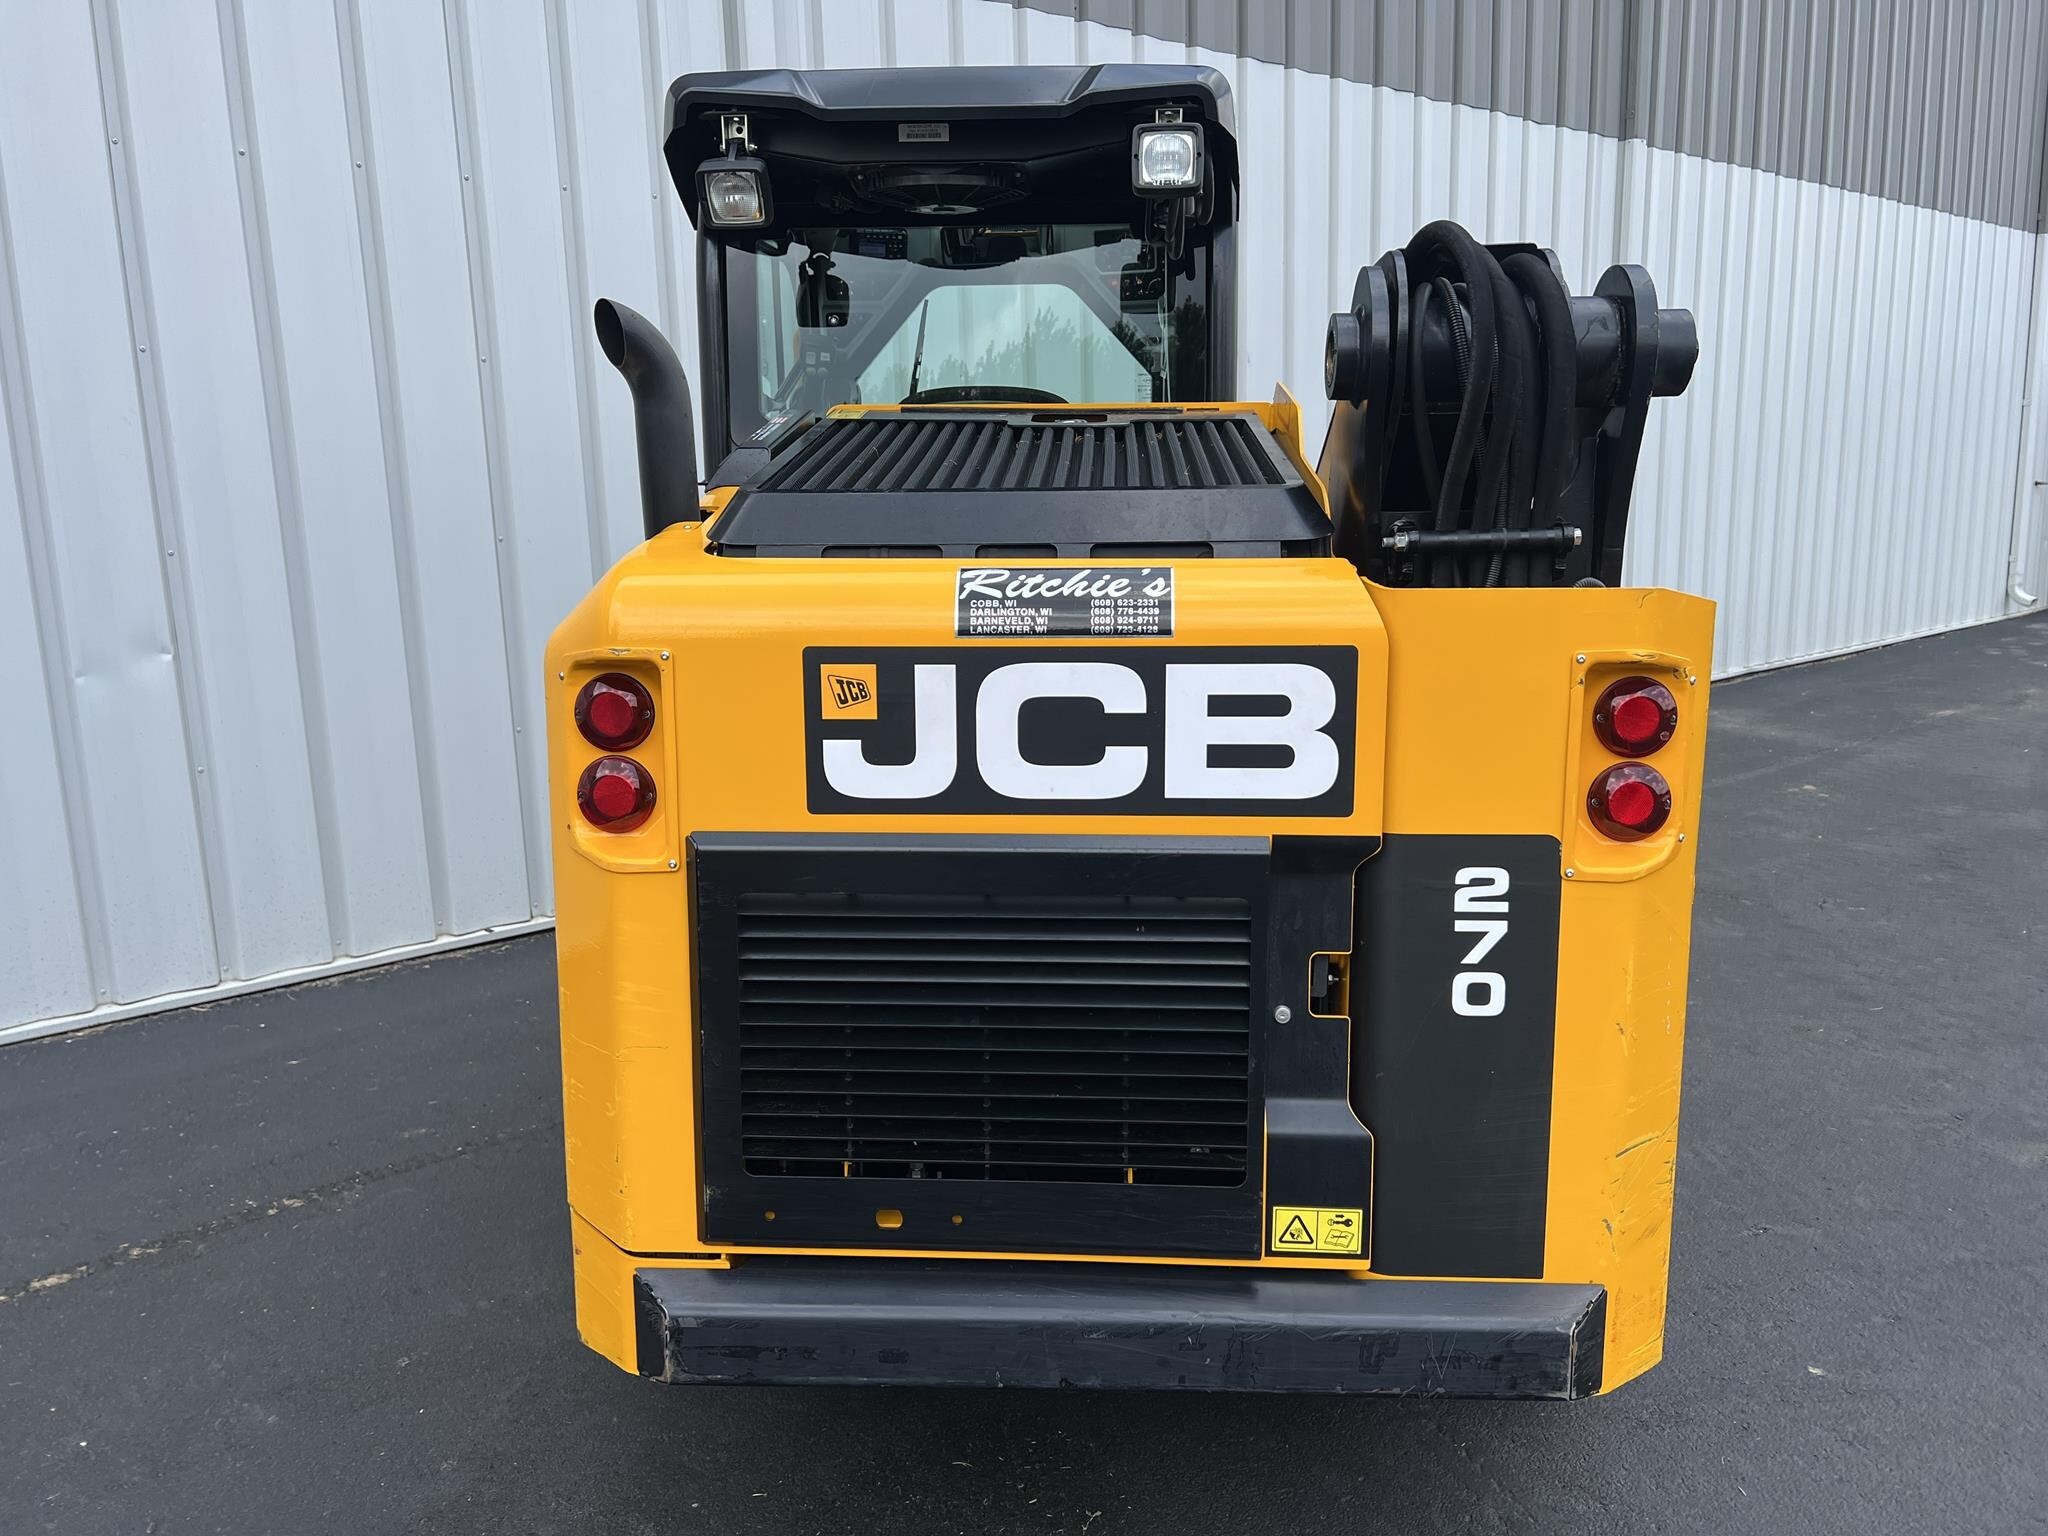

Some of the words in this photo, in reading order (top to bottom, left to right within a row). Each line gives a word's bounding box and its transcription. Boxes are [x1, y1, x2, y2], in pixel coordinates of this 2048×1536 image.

[959, 567, 1171, 600] Ritchie's
[970, 599, 1002, 608] COBB,
[1005, 599, 1017, 607] WI
[1091, 599, 1115, 608] (608)
[1117, 599, 1159, 607] 623-2331
[970, 608, 1039, 617] DARLINGTON,
[1040, 608, 1053, 616] WI
[1091, 607, 1115, 617] (608)
[970, 617, 1034, 626] BARNEVELD,
[1036, 617, 1049, 625] WI
[1091, 616, 1115, 625] (608)
[1117, 616, 1159, 624] 924-9711
[970, 625, 1033, 634] LANCASTER,
[1034, 625, 1047, 633] WI
[1091, 625, 1115, 634] (608)
[835, 678, 870, 706] JCB
[822, 661, 1340, 800] JCB
[1451, 866, 1510, 1017] 270
